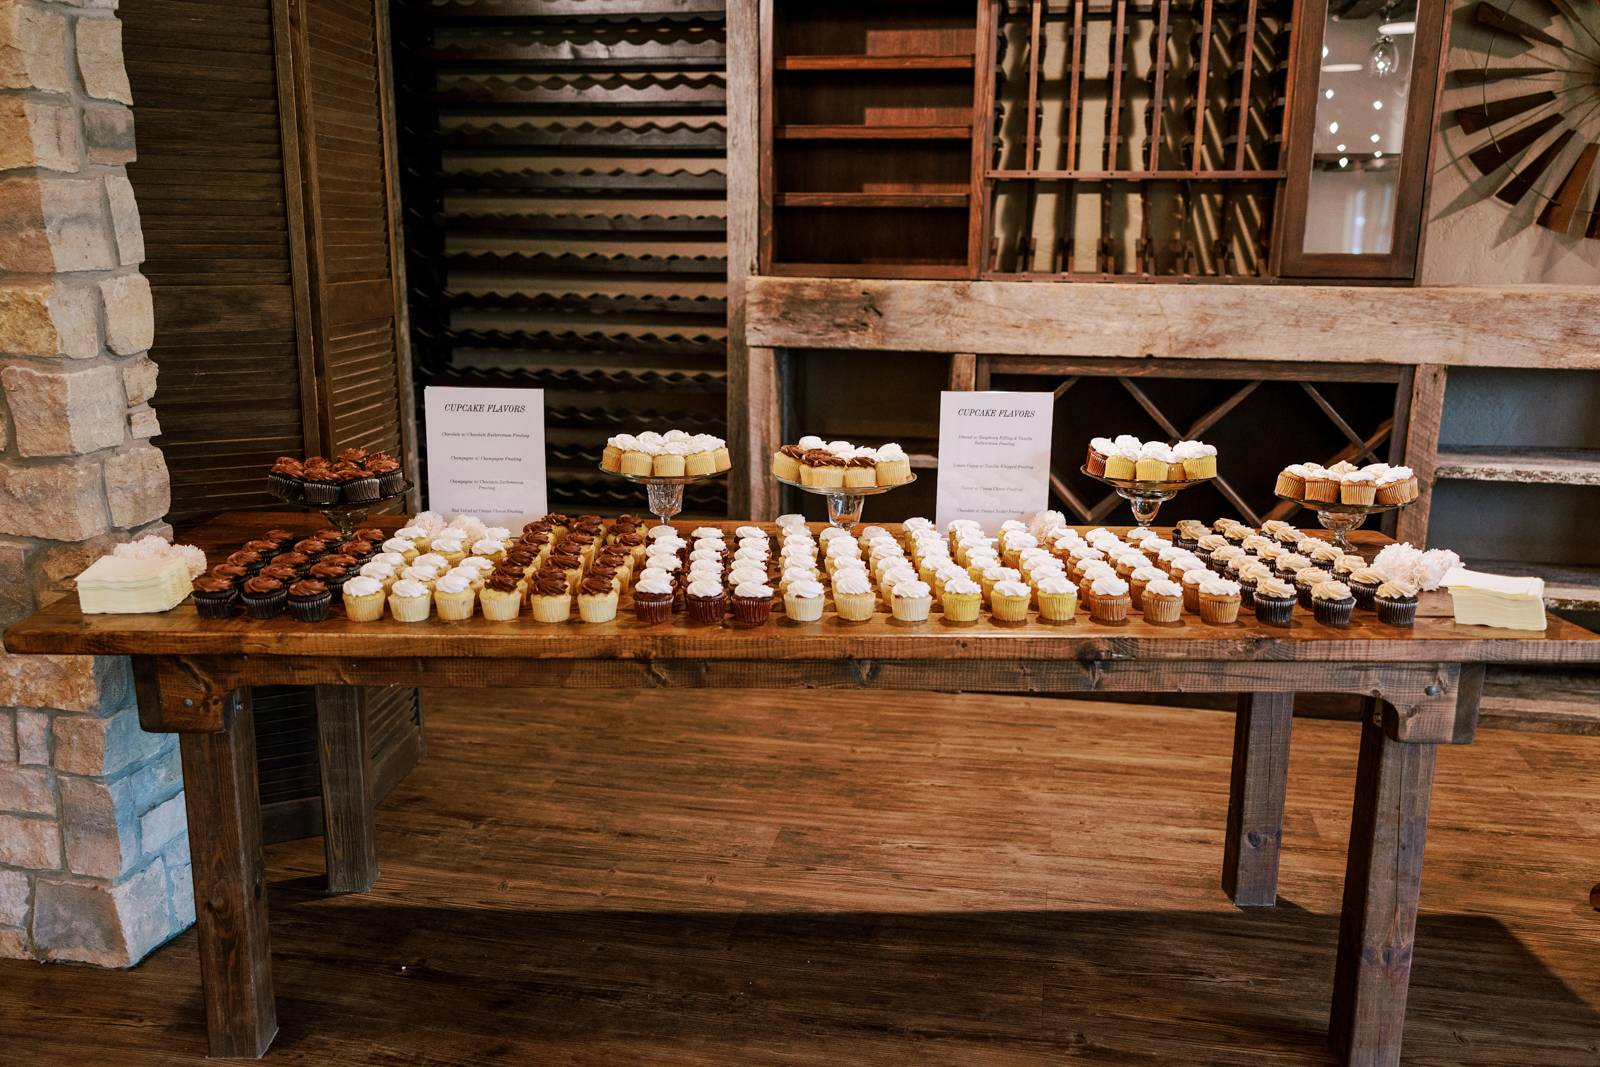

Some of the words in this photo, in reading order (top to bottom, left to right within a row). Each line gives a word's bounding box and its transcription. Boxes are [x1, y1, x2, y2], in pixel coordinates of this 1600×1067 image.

[444, 403, 485, 413] CUPCAKE
[487, 404, 526, 413] FLAVORS
[958, 408, 997, 417] CUPCAKE
[998, 409, 1036, 418] FLAVORS
